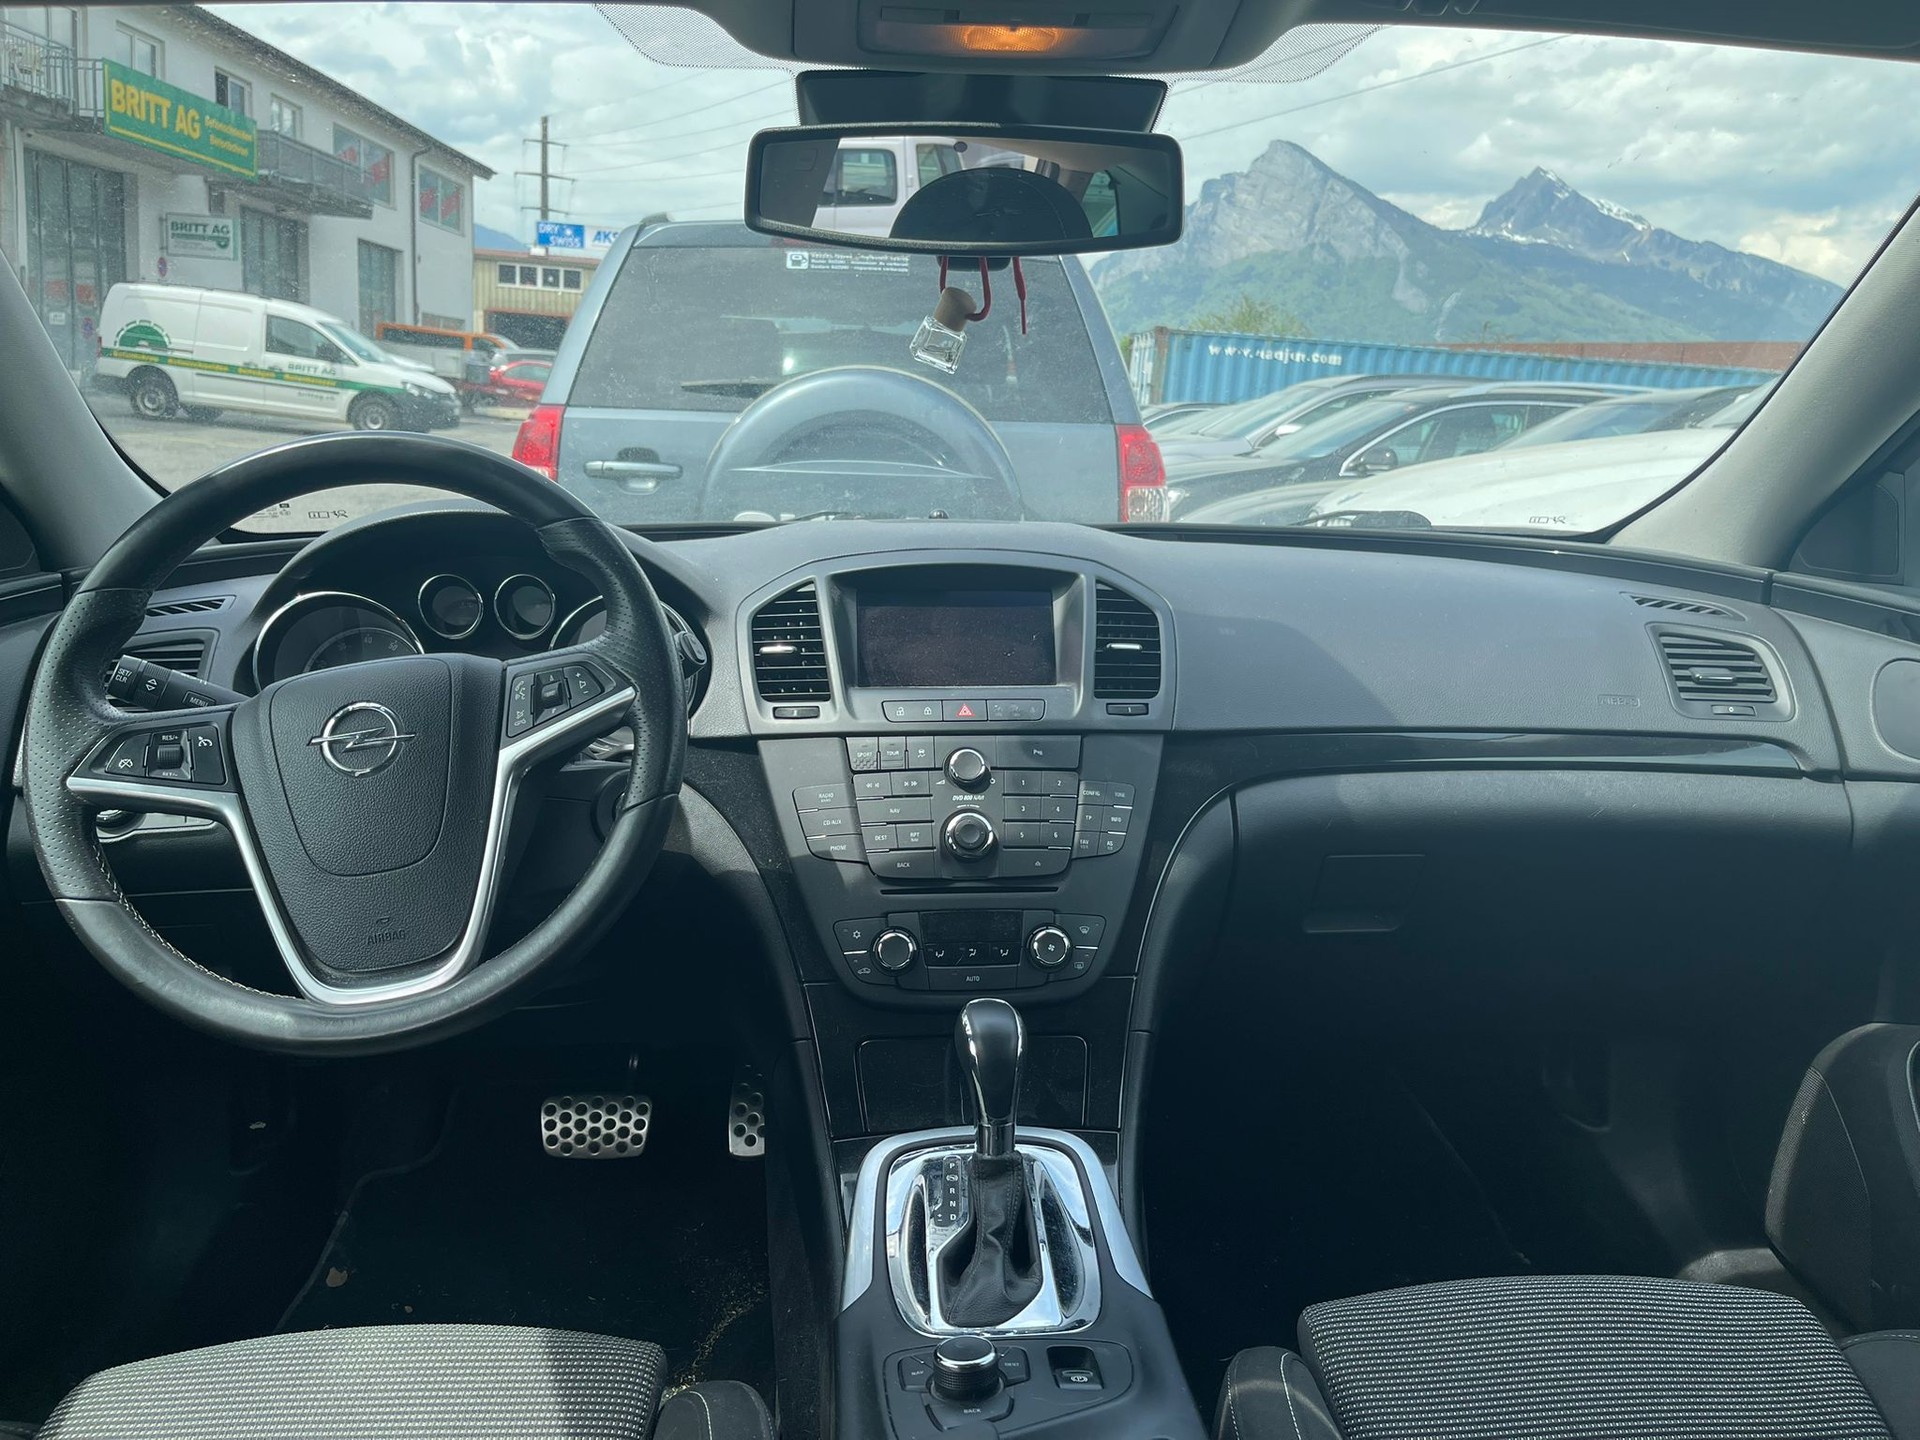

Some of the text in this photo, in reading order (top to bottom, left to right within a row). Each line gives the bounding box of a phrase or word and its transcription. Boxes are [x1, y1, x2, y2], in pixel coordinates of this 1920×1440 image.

[111, 78, 172, 129] BRITT
[175, 104, 201, 140] AG
[170, 221, 230, 235] BRITT AG
[549, 235, 580, 248] SWISS
[287, 363, 319, 374] BRITT
[321, 367, 337, 377] AG
[115, 675, 128, 683] CLR
[117, 668, 132, 677] SET/
[367, 929, 406, 945] AIRBAG
[950, 1213, 957, 1221] D
